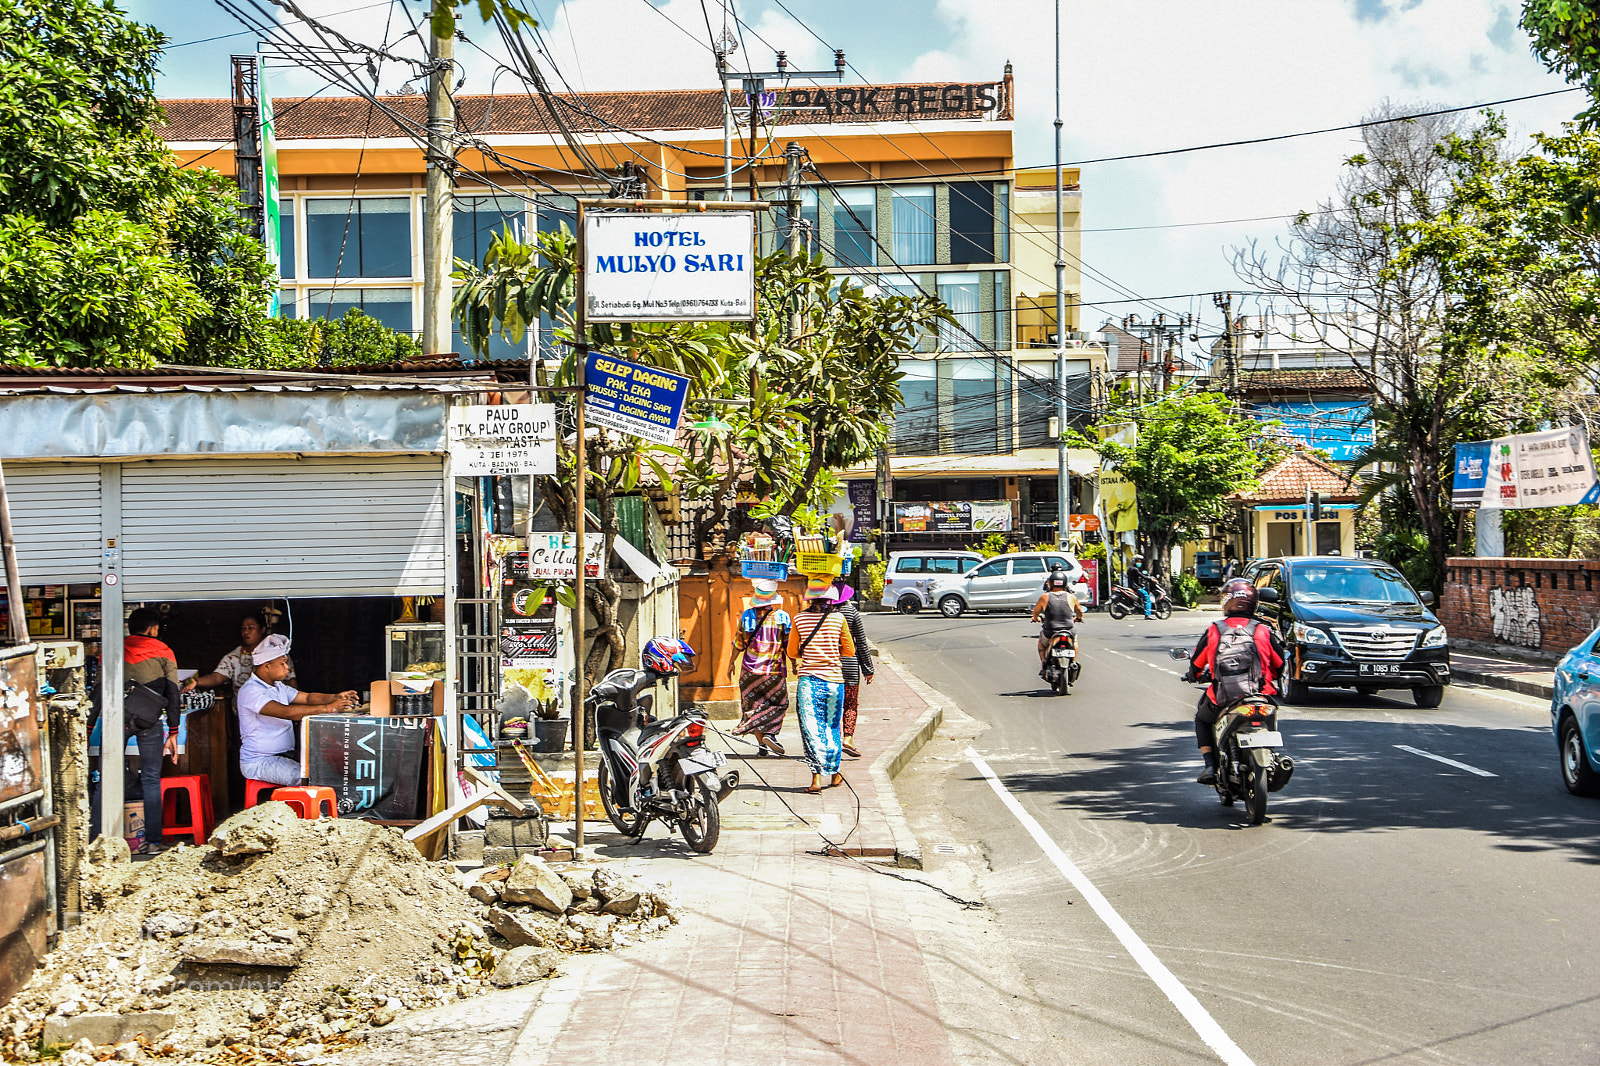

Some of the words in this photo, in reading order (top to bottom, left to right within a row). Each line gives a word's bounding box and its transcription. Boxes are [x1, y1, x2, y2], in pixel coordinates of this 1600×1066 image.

[790, 87, 880, 116] PARK
[894, 84, 997, 114] REGIS
[634, 232, 706, 246] HOTEL
[596, 254, 676, 274] MULYO
[684, 254, 744, 272] SARI
[601, 300, 631, 308] Setiabudi
[595, 358, 632, 378] SELEP
[632, 369, 678, 392] DAGING
[606, 377, 628, 392] PAK.
[631, 384, 651, 398] EKA
[623, 394, 652, 408] DAGING
[652, 402, 672, 414] SAPI
[486, 409, 519, 421] PAUD
[619, 404, 648, 418] DAGING
[648, 413, 670, 425] AYAM
[479, 423, 505, 435] PLAY
[509, 421, 547, 434] GROUP
